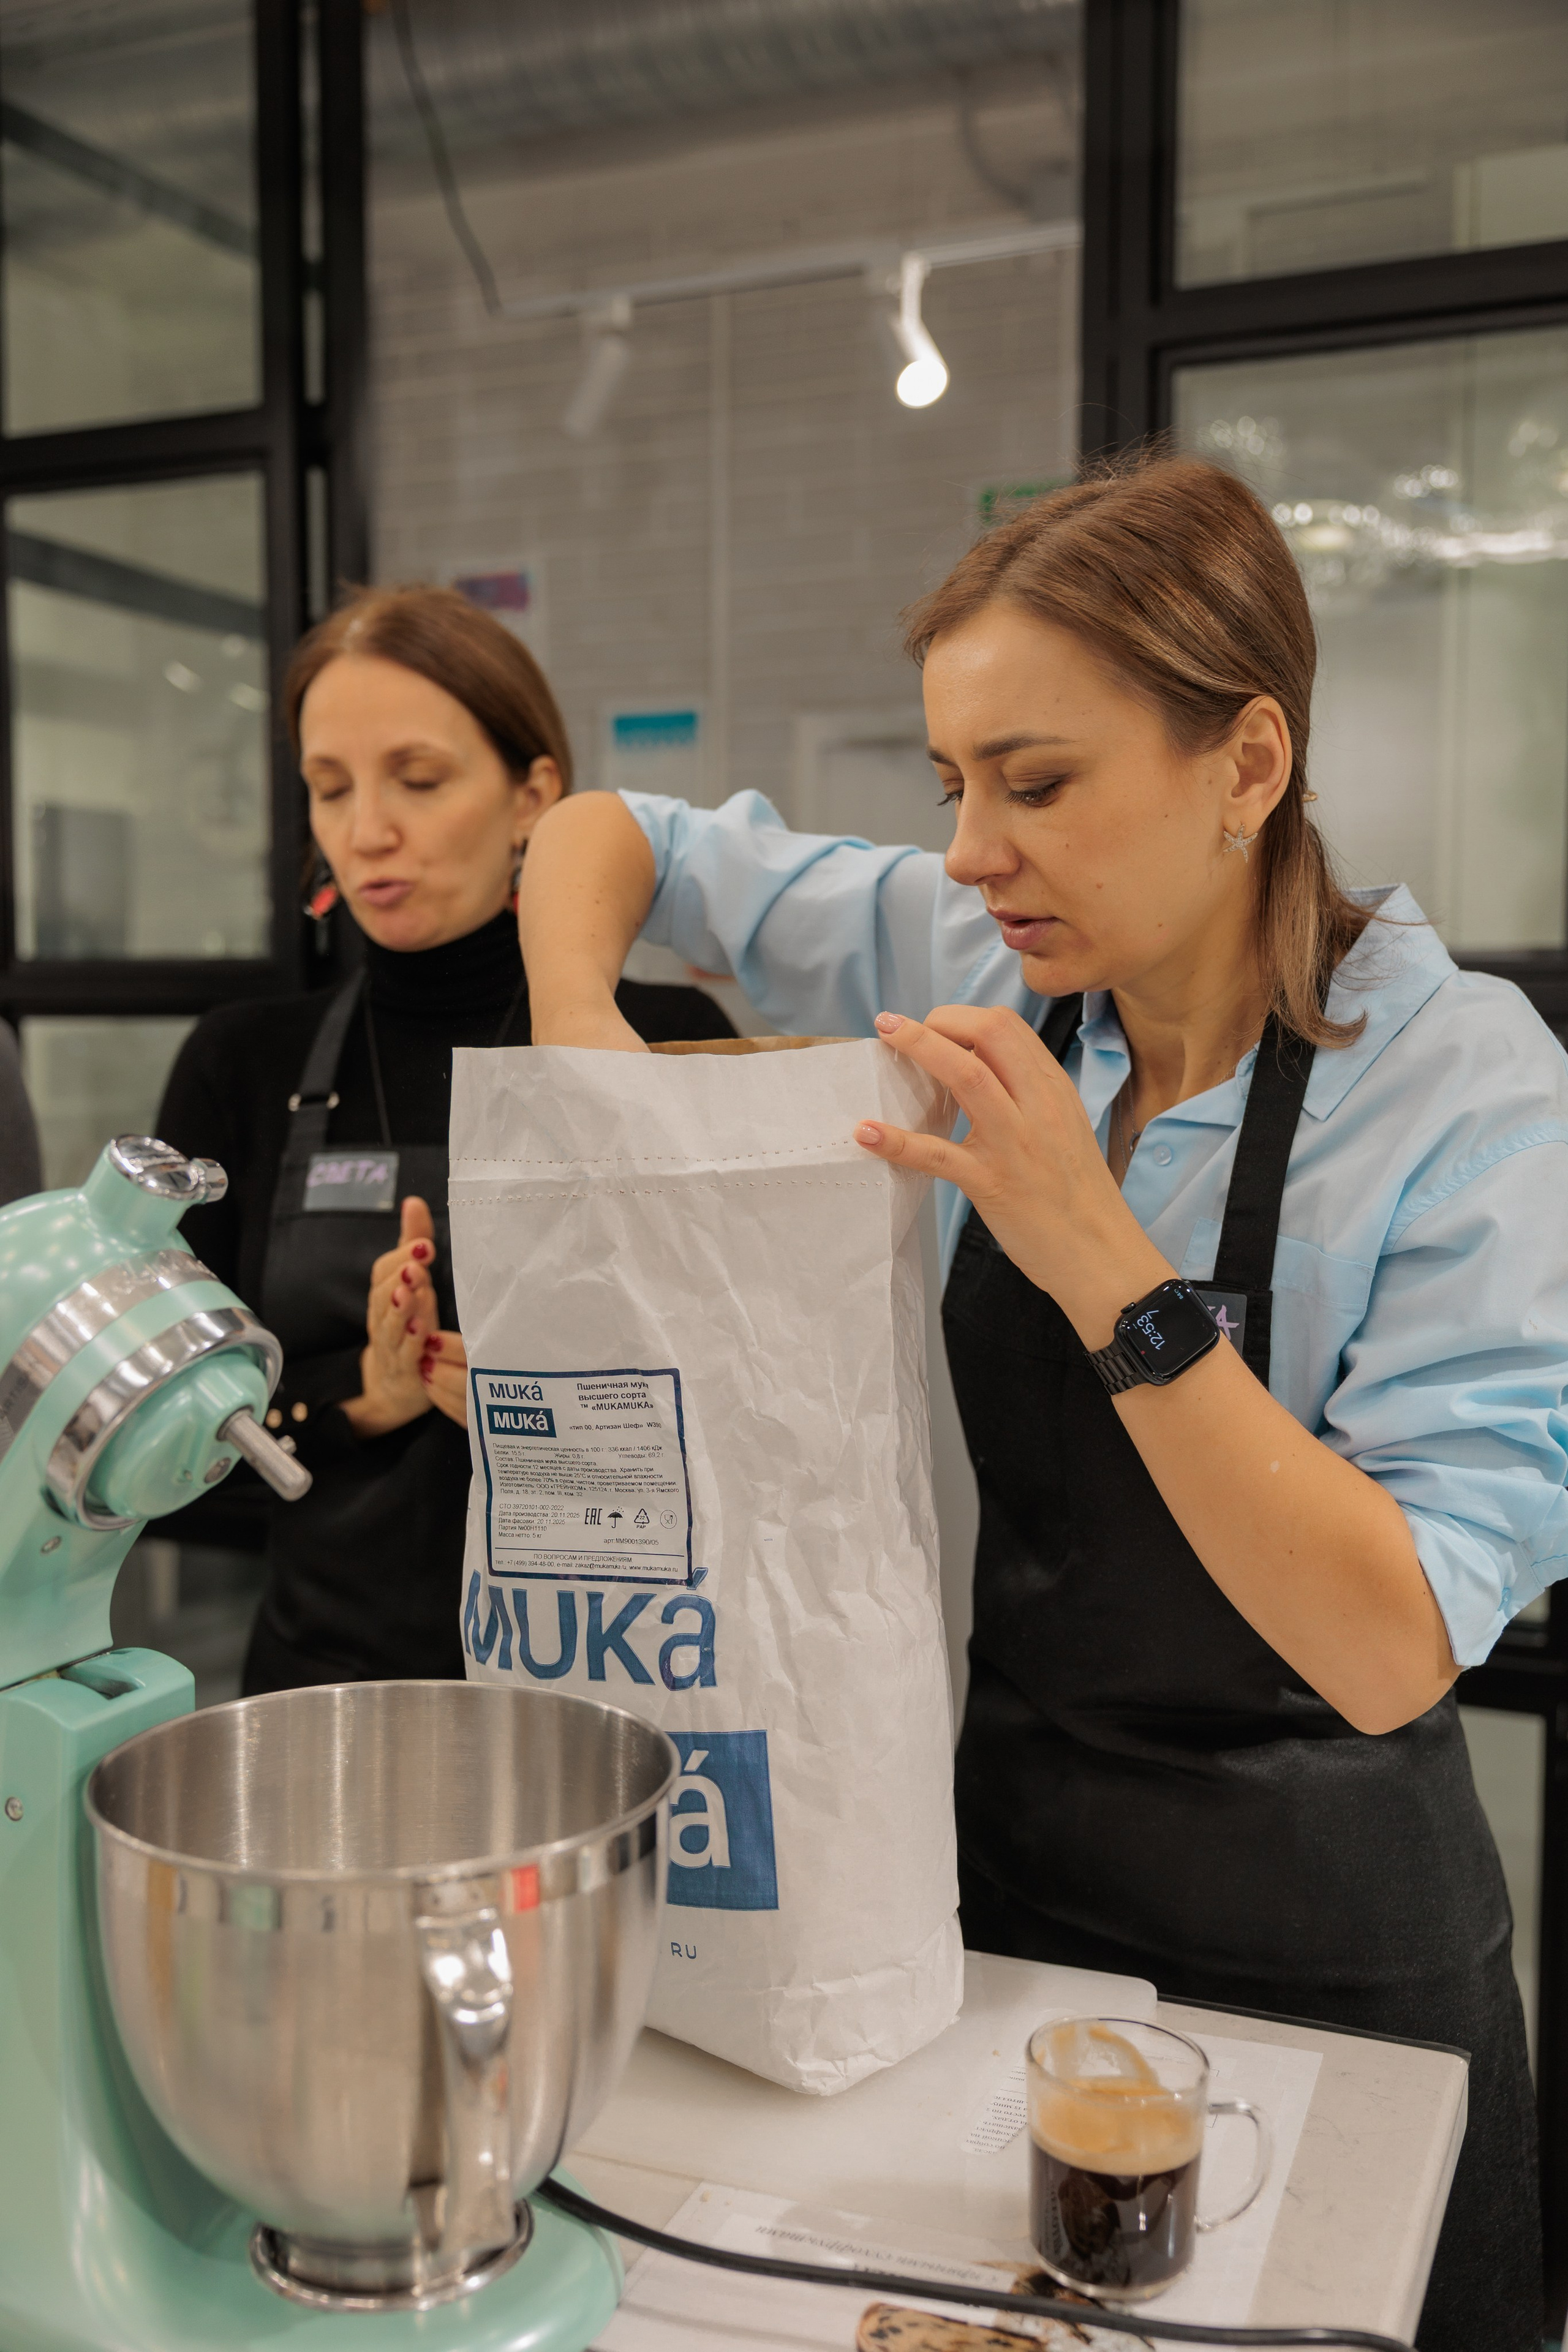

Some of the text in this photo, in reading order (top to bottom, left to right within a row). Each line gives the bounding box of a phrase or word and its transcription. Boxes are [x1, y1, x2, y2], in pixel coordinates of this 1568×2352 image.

[1137, 1315, 1165, 1350] 12:53
[577, 1382, 628, 1390] Пшеничная
[592, 1401, 654, 1411] «MUKAMUKA»
